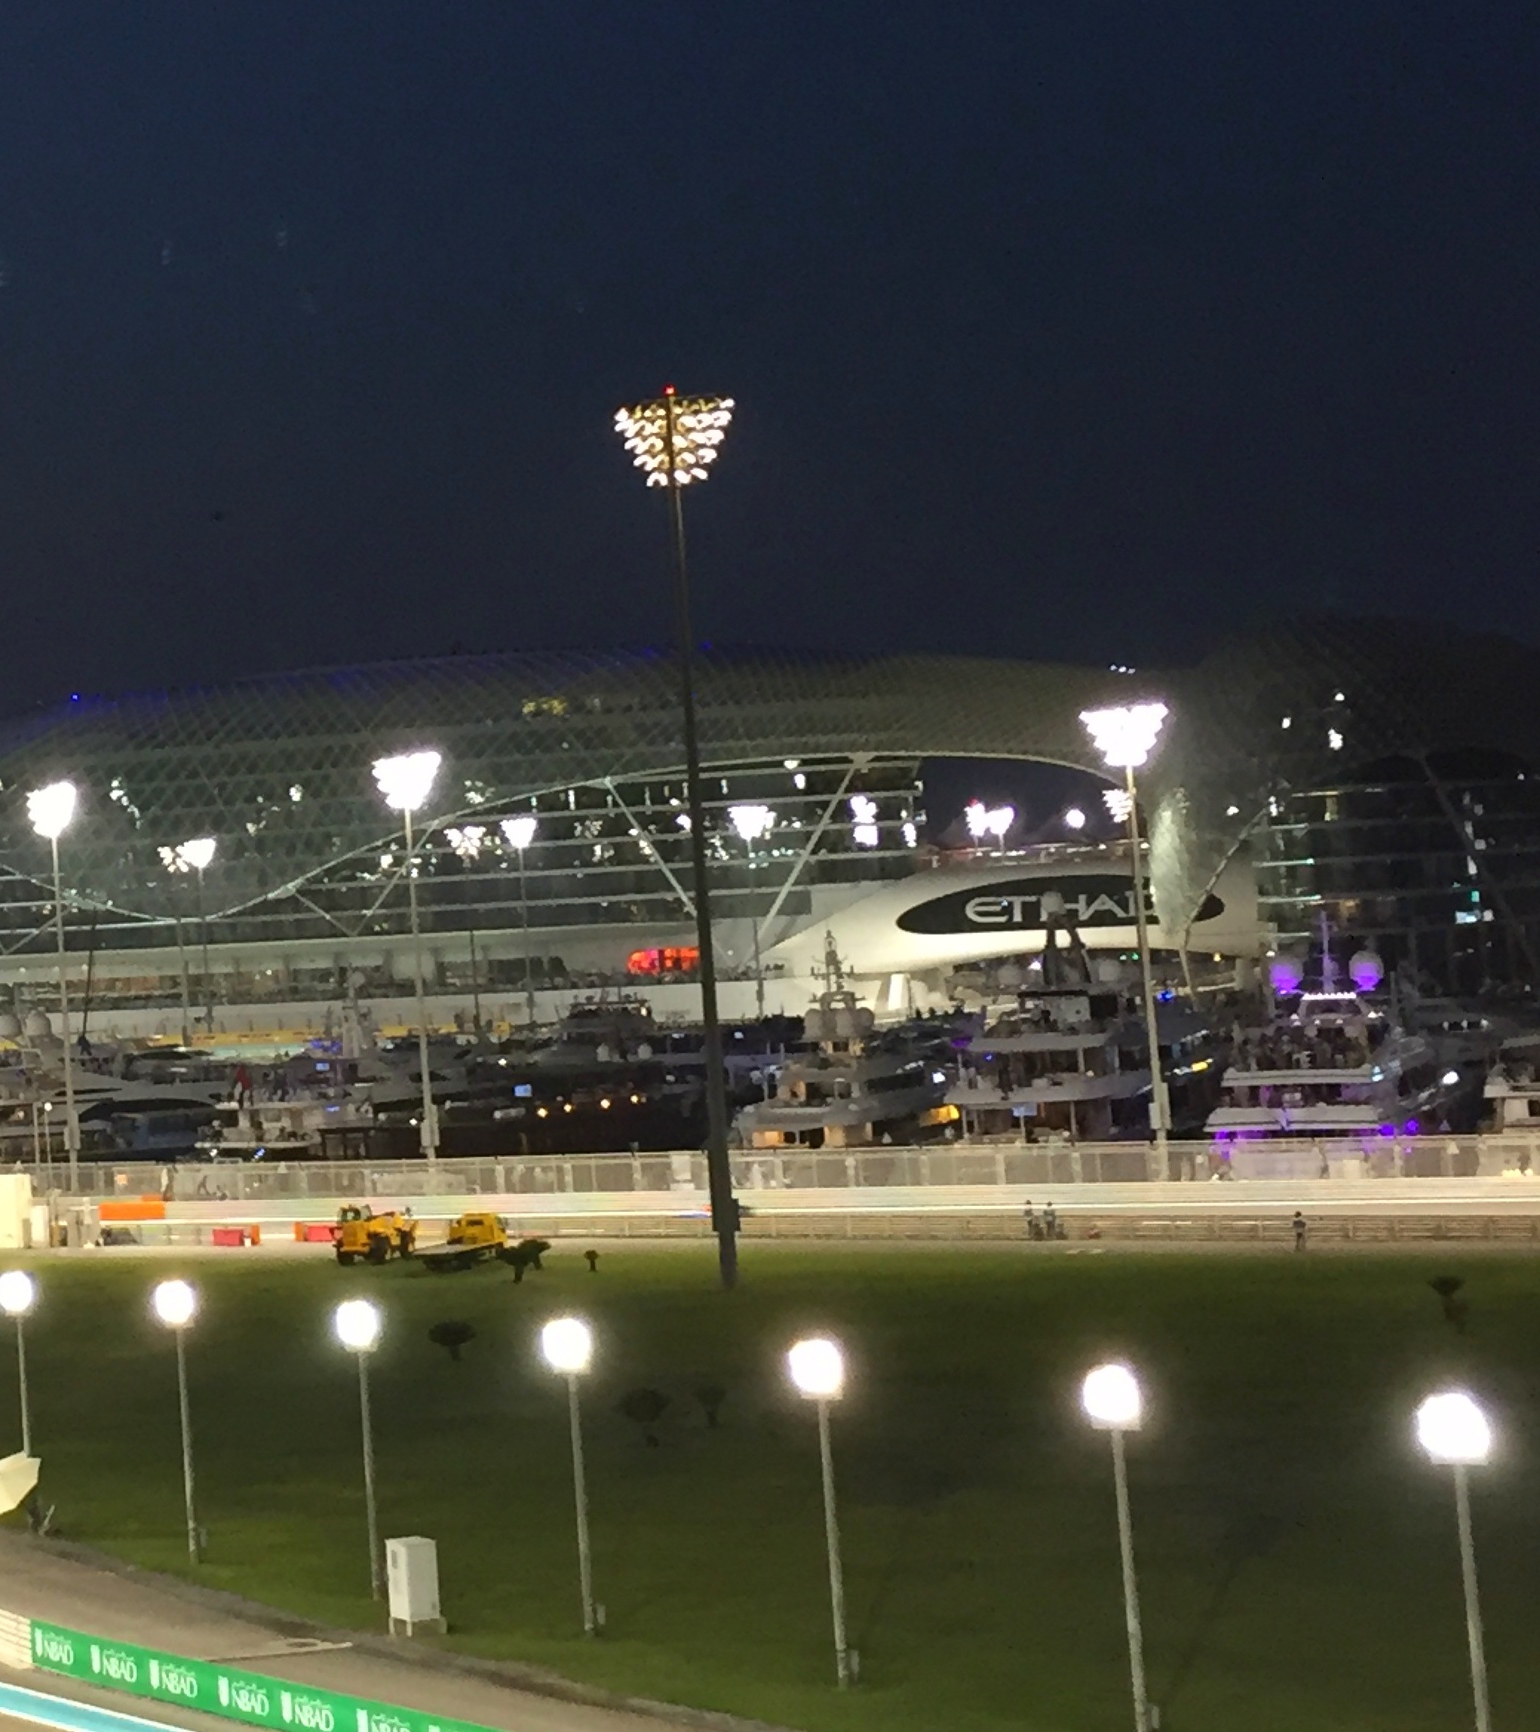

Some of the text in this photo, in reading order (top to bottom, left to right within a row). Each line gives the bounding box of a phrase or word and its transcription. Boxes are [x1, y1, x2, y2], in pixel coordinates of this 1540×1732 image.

[44, 1640, 74, 1665] NBAD
[103, 1656, 137, 1683] NBAD
[162, 1671, 198, 1698] NBAD
[231, 1688, 269, 1716] NBAD
[295, 1703, 334, 1732] NBAD
